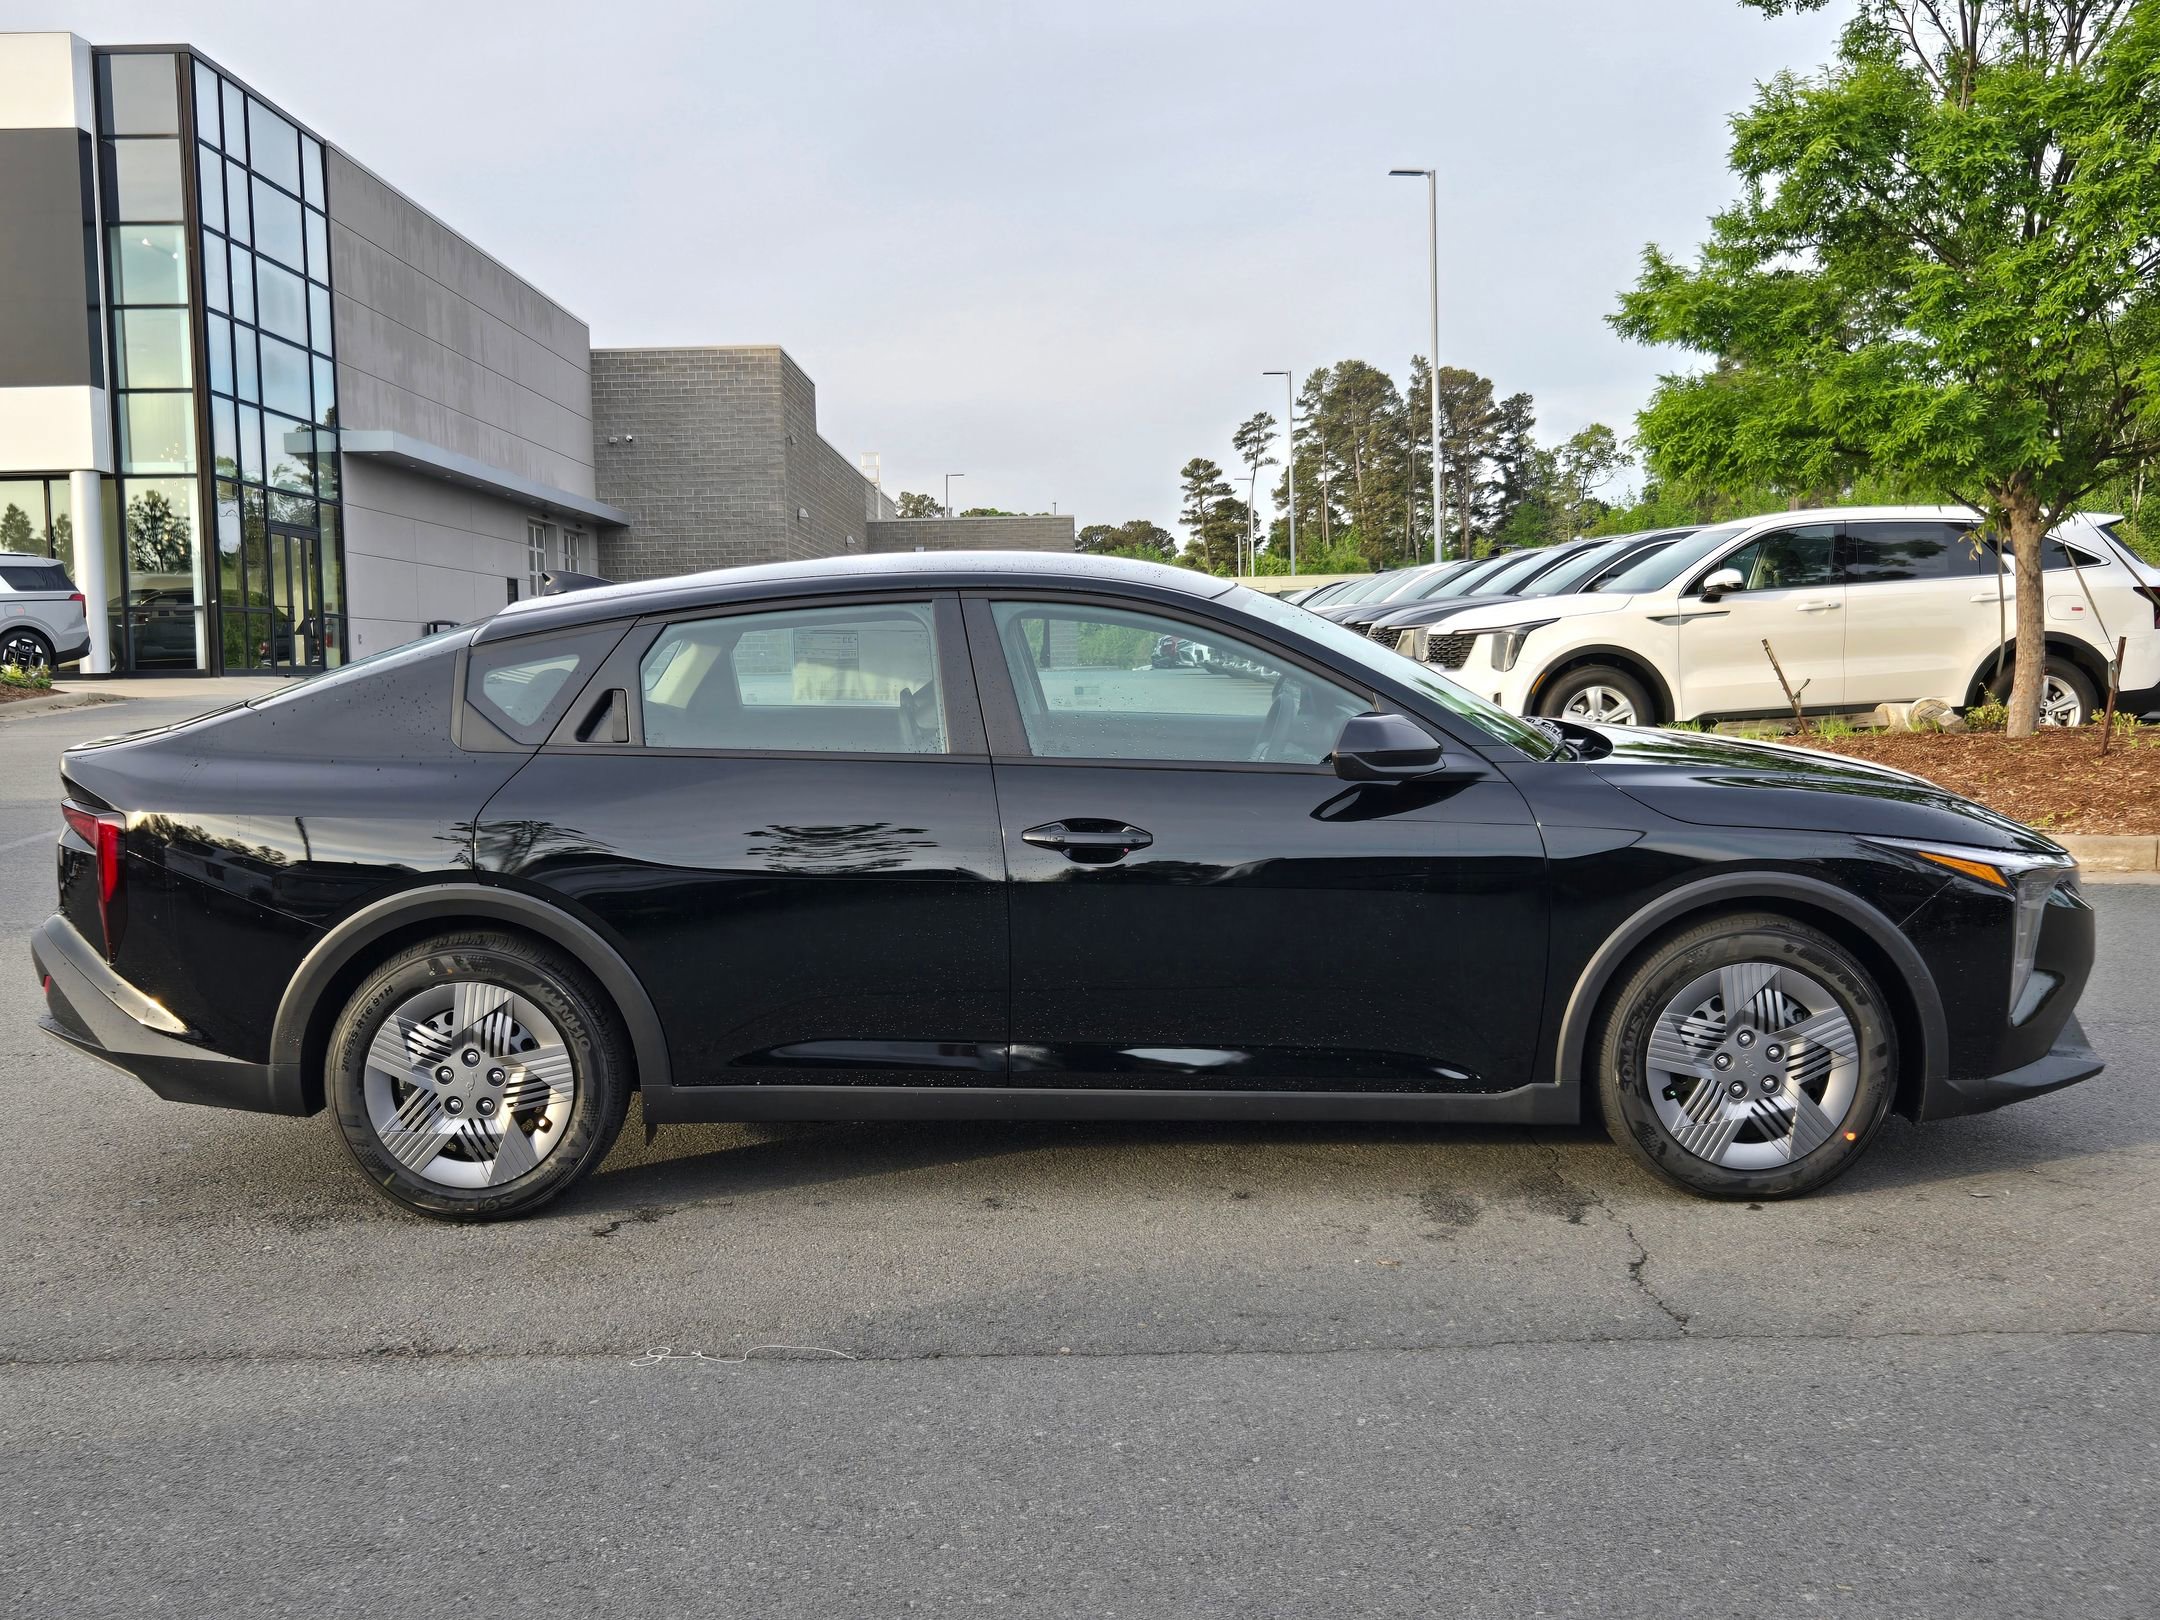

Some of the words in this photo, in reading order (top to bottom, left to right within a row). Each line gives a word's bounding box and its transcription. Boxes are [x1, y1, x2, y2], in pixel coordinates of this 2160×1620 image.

[341, 1029, 359, 1073] 205/55
[355, 1005, 374, 1031] R16
[371, 984, 394, 1008] 91H
[541, 984, 592, 1052] KUMHO
